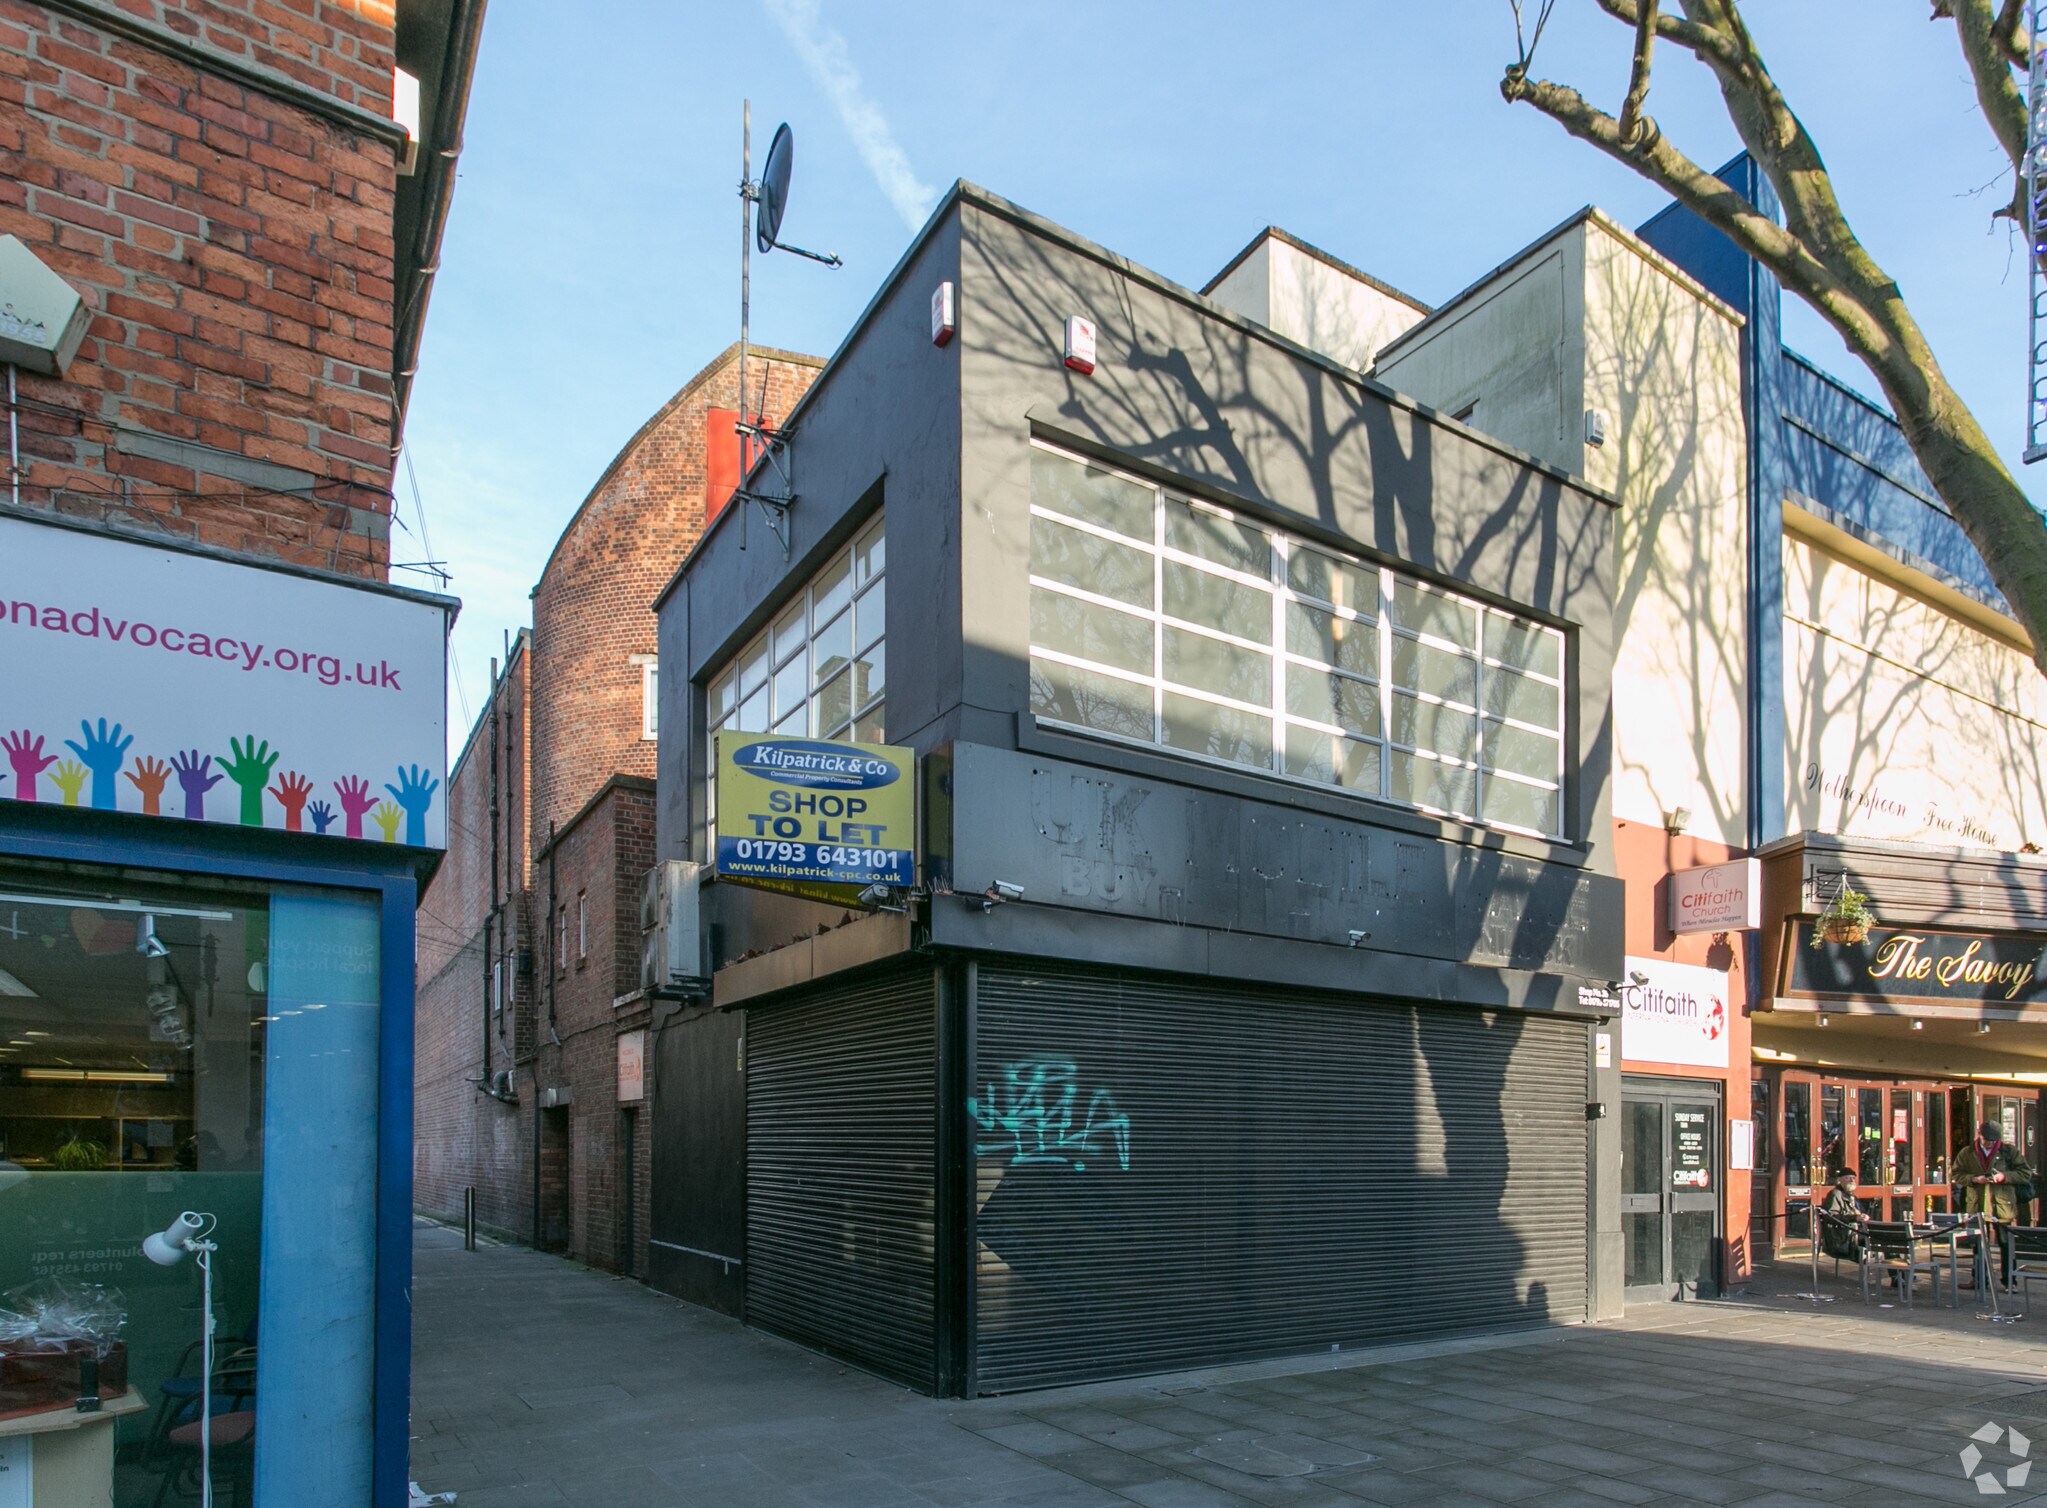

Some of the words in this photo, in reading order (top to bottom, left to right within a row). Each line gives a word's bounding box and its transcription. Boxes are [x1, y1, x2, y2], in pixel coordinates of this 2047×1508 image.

[0, 601, 401, 690] nadvocacy.org.uk
[753, 746, 844, 771] Kilpatrick
[848, 758, 862, 773] &
[865, 760, 887, 775] Co
[770, 770, 804, 779] Commercial
[804, 774, 829, 783] Property
[830, 777, 863, 785] Consultants
[768, 790, 867, 818] SHOP
[1806, 761, 1908, 820] Wetherspoon
[1922, 801, 1955, 835] Free
[1957, 815, 1998, 847] House
[748, 814, 801, 838] TO
[818, 820, 887, 845] LET
[737, 839, 806, 862] 01793
[817, 846, 898, 869] 643101
[728, 862, 901, 882] www.kilpatrick-cpc.co.uk
[1681, 889, 1743, 908] Citifaith
[1692, 905, 1731, 918] Church
[1868, 936, 1931, 980] The
[1936, 940, 2037, 1000] Savoy
[1626, 986, 1697, 1017] Citifaith
